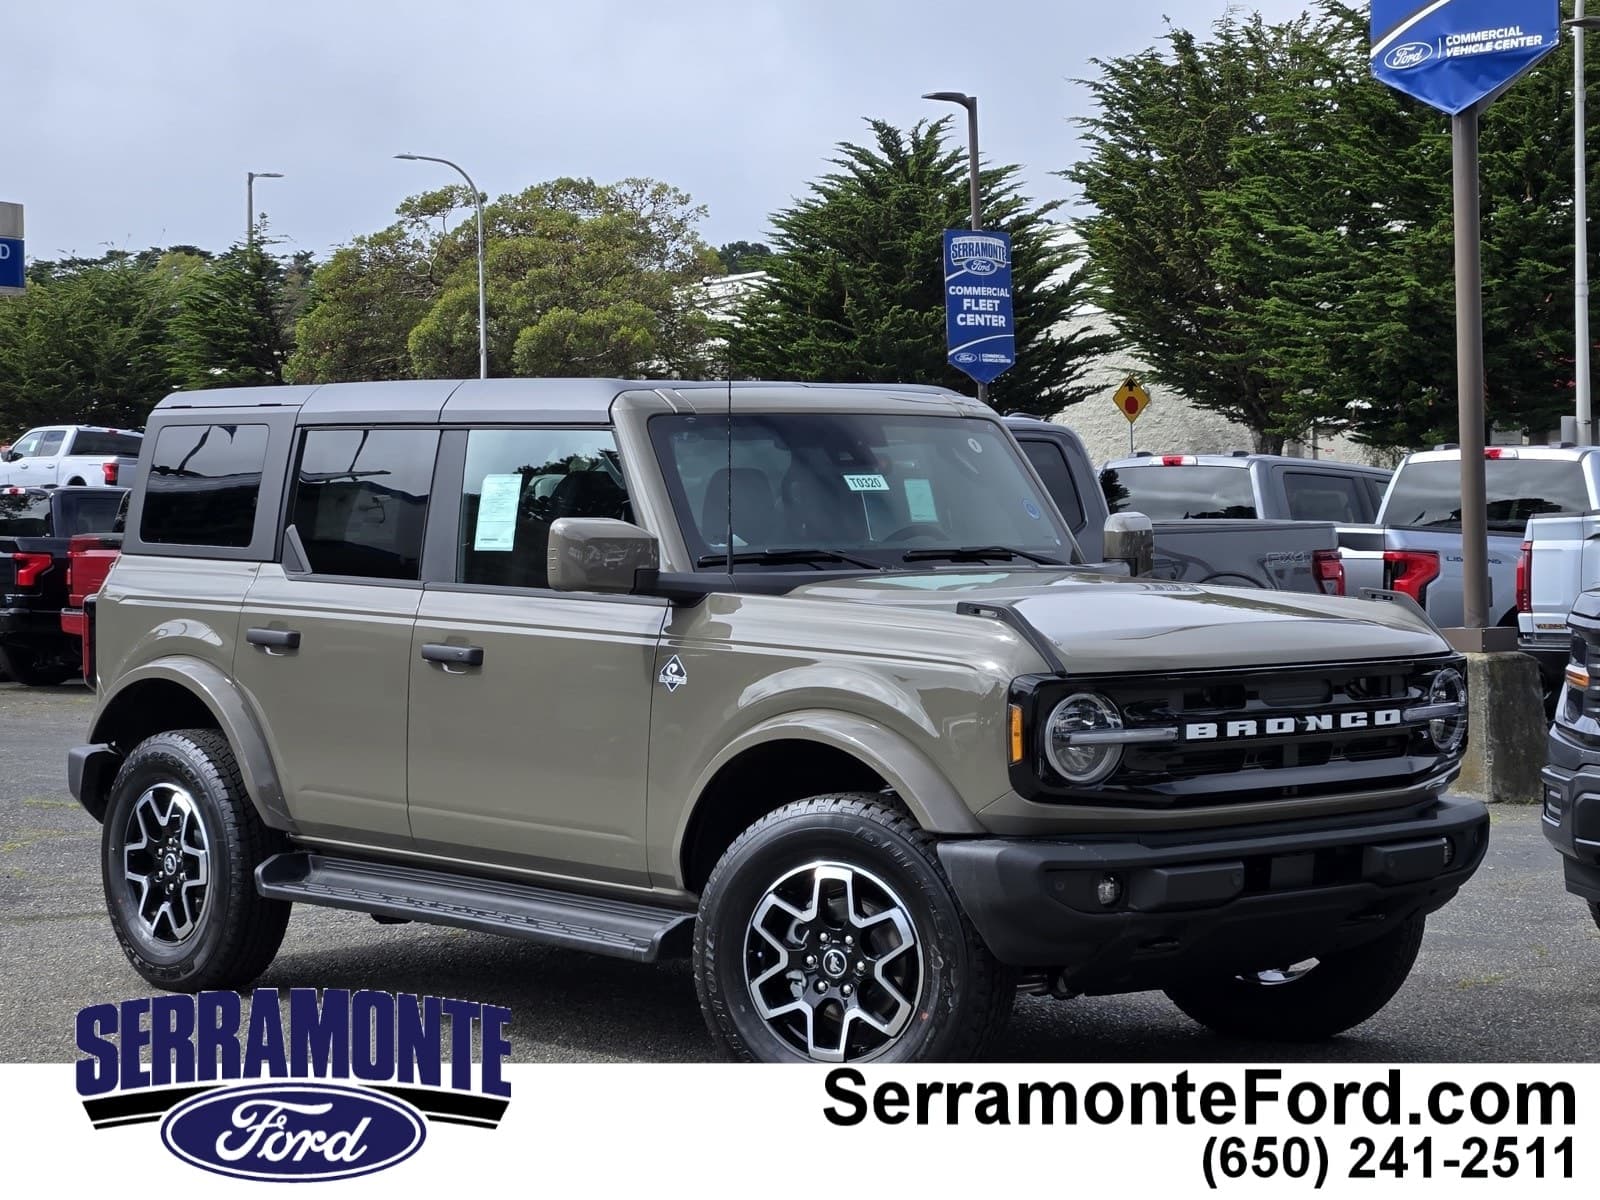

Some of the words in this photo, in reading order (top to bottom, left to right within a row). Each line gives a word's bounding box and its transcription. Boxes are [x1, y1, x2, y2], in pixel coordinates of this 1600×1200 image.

[1445, 25, 1524, 46] COMMERCIAL
[1446, 41, 1493, 58] VEHICLE
[1493, 35, 1543, 51] CENTER
[1392, 46, 1424, 66] Ford
[951, 241, 1006, 262] SERRAMONTE
[971, 260, 991, 272] Ford
[949, 286, 1010, 298] COMMERCIAL
[963, 298, 1000, 312] FLEET
[956, 313, 1006, 327] CENTER
[849, 477, 882, 489] T0320
[1266, 552, 1305, 568] FX4
[1185, 709, 1401, 740] BRONCO
